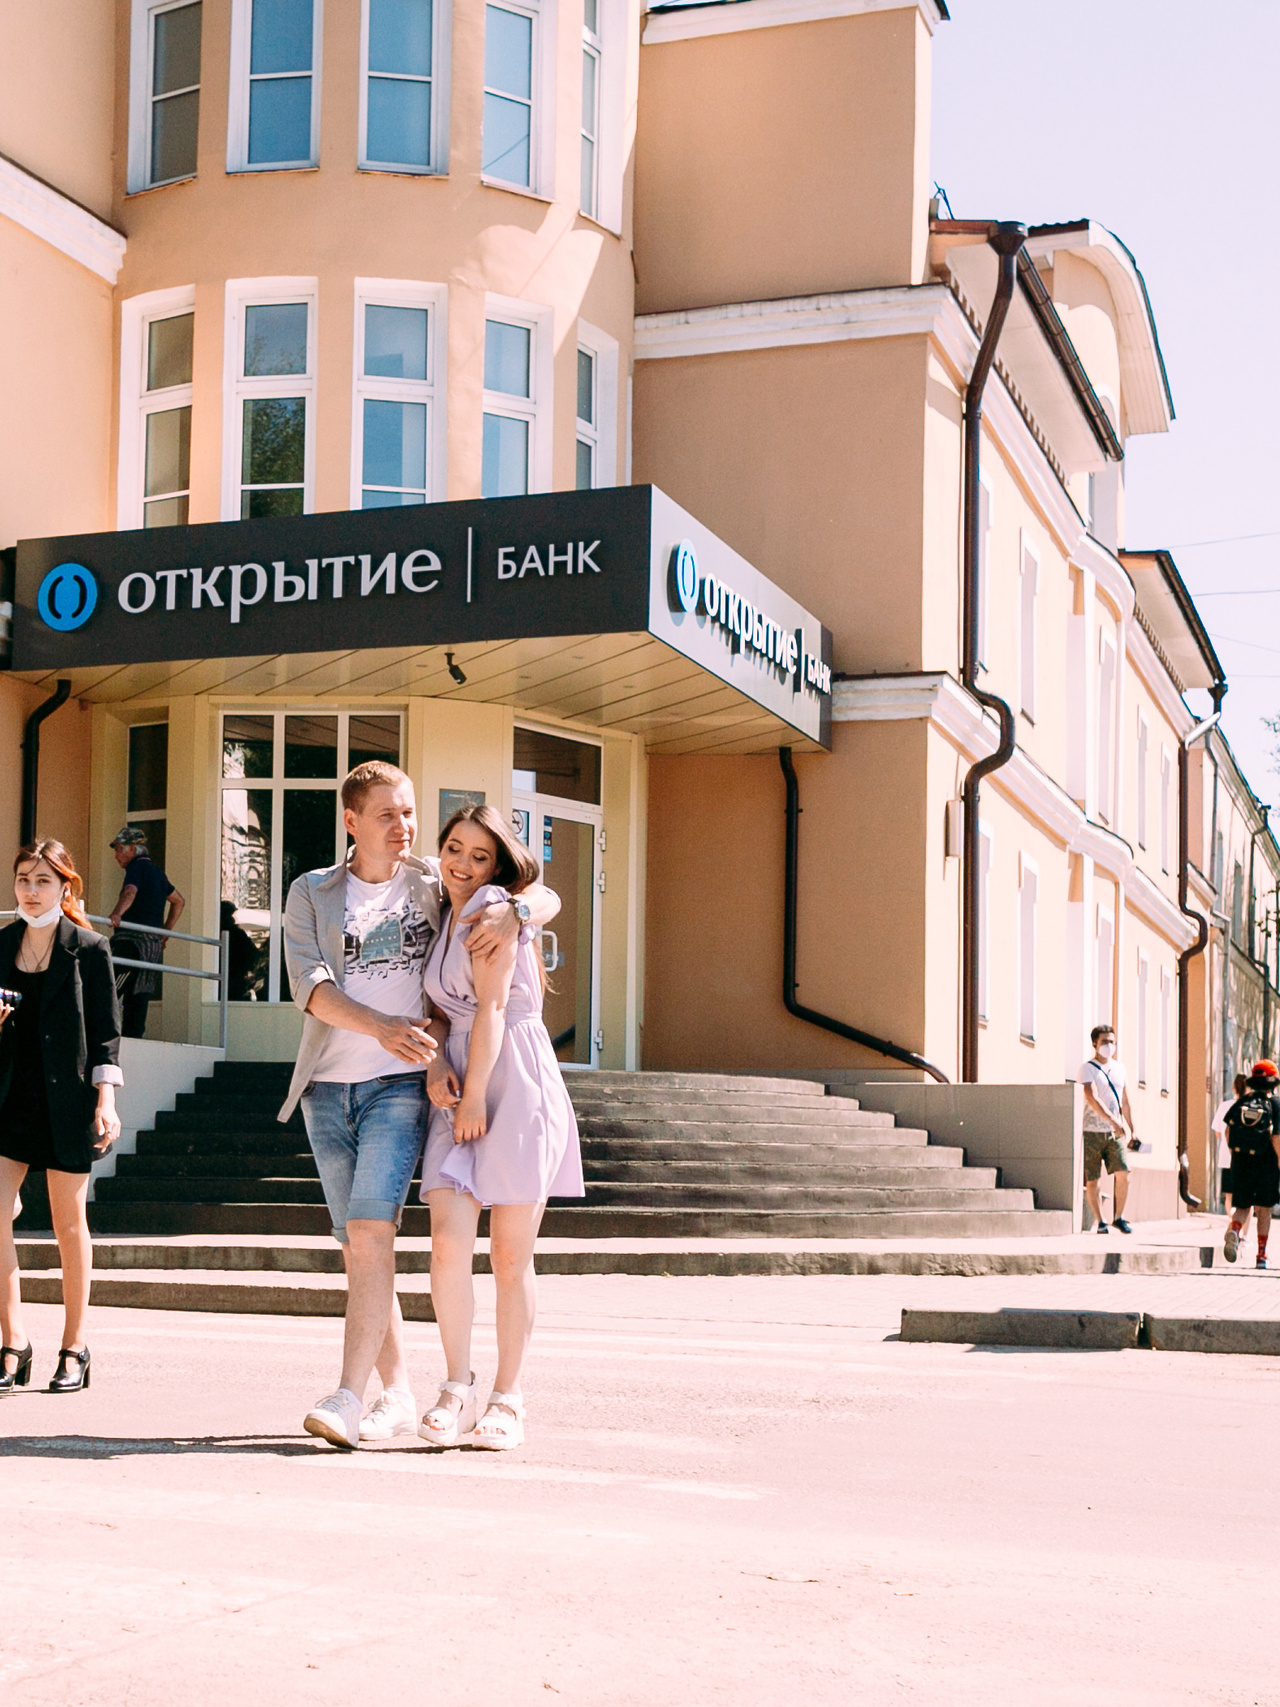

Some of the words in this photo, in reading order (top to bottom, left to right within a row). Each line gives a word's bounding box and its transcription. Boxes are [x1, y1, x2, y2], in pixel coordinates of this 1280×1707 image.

[118, 548, 443, 625] открытие
[496, 539, 603, 580] БАНК
[703, 572, 798, 676] открытие
[807, 653, 832, 696] БАНК
